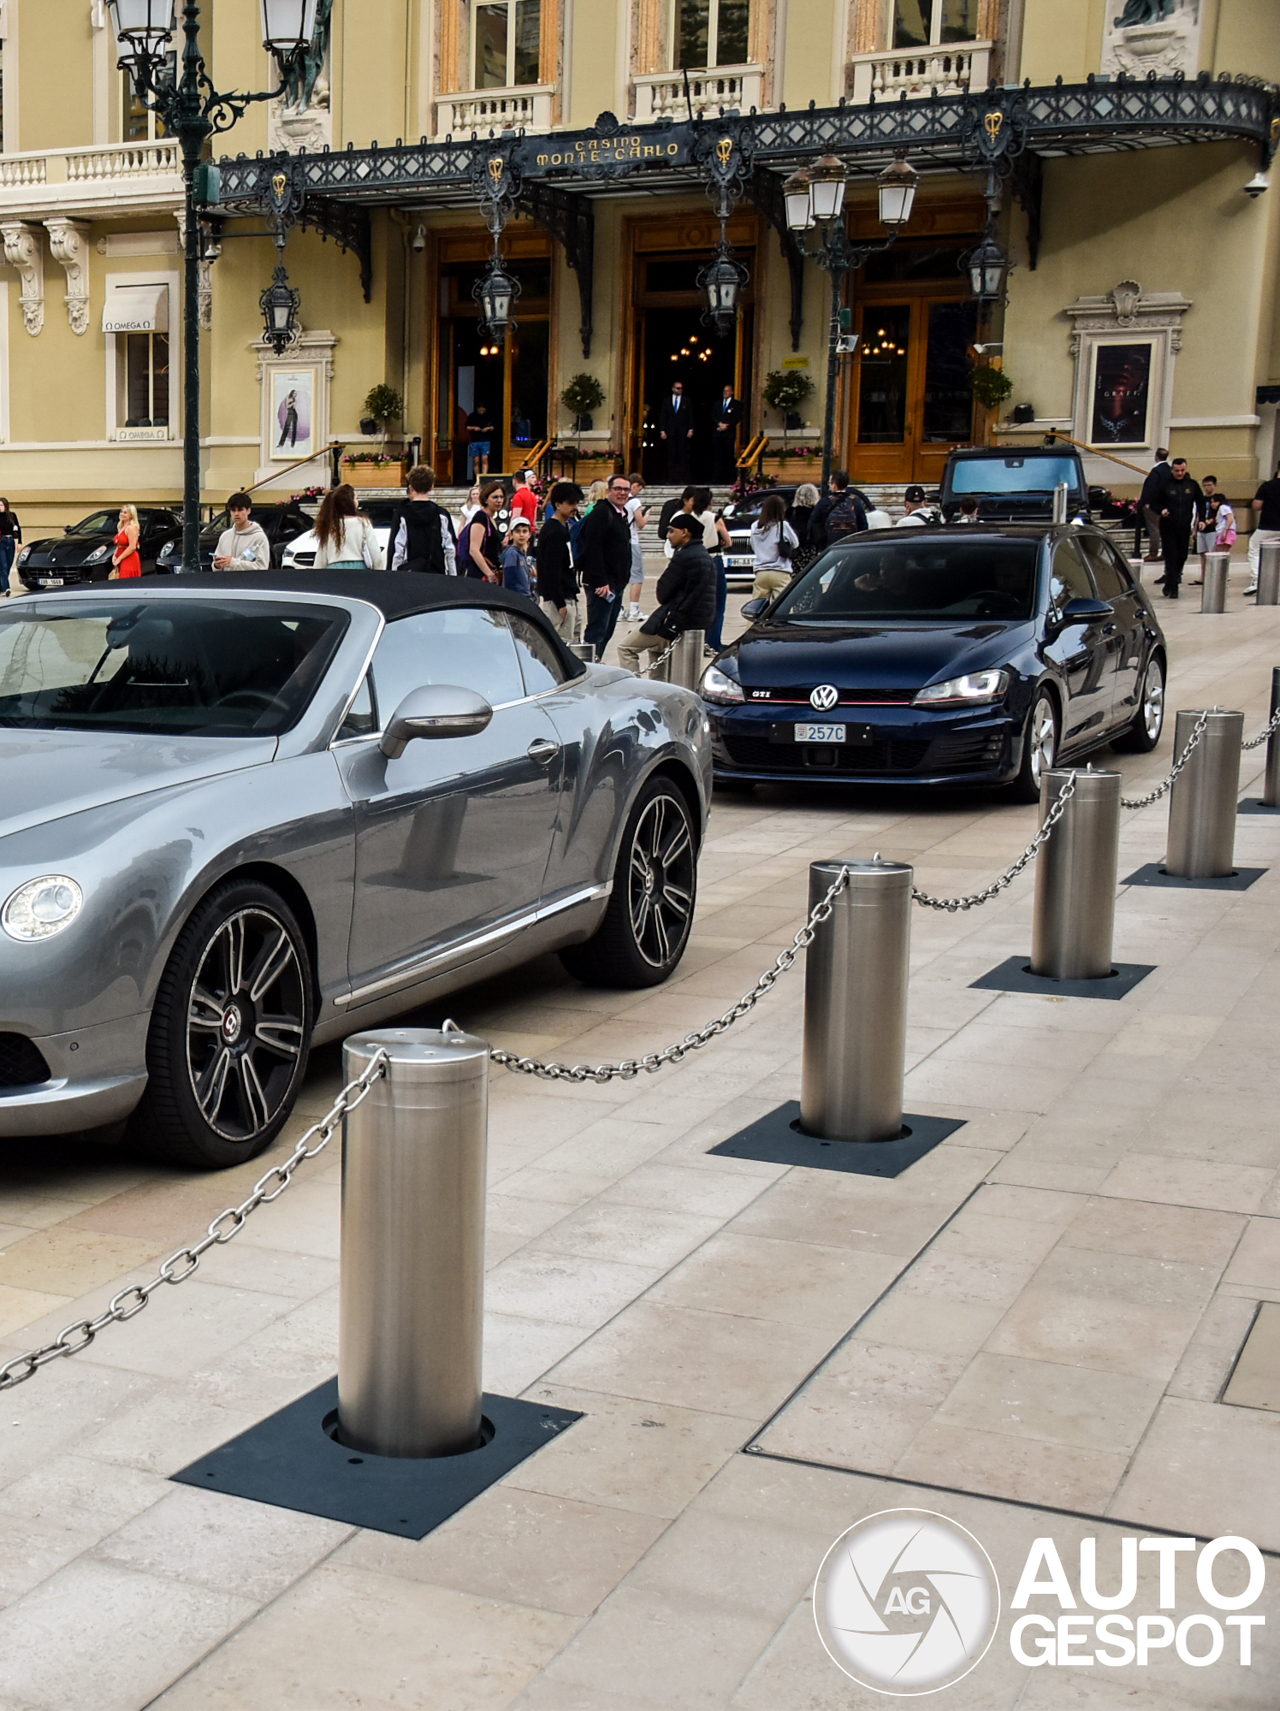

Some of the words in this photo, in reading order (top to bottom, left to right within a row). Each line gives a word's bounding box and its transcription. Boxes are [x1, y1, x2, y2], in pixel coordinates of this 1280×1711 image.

[575, 136, 641, 152] CASINO
[114, 321, 142, 330] OMEGA
[129, 431, 155, 439] OMEGA
[808, 727, 844, 740] 257C
